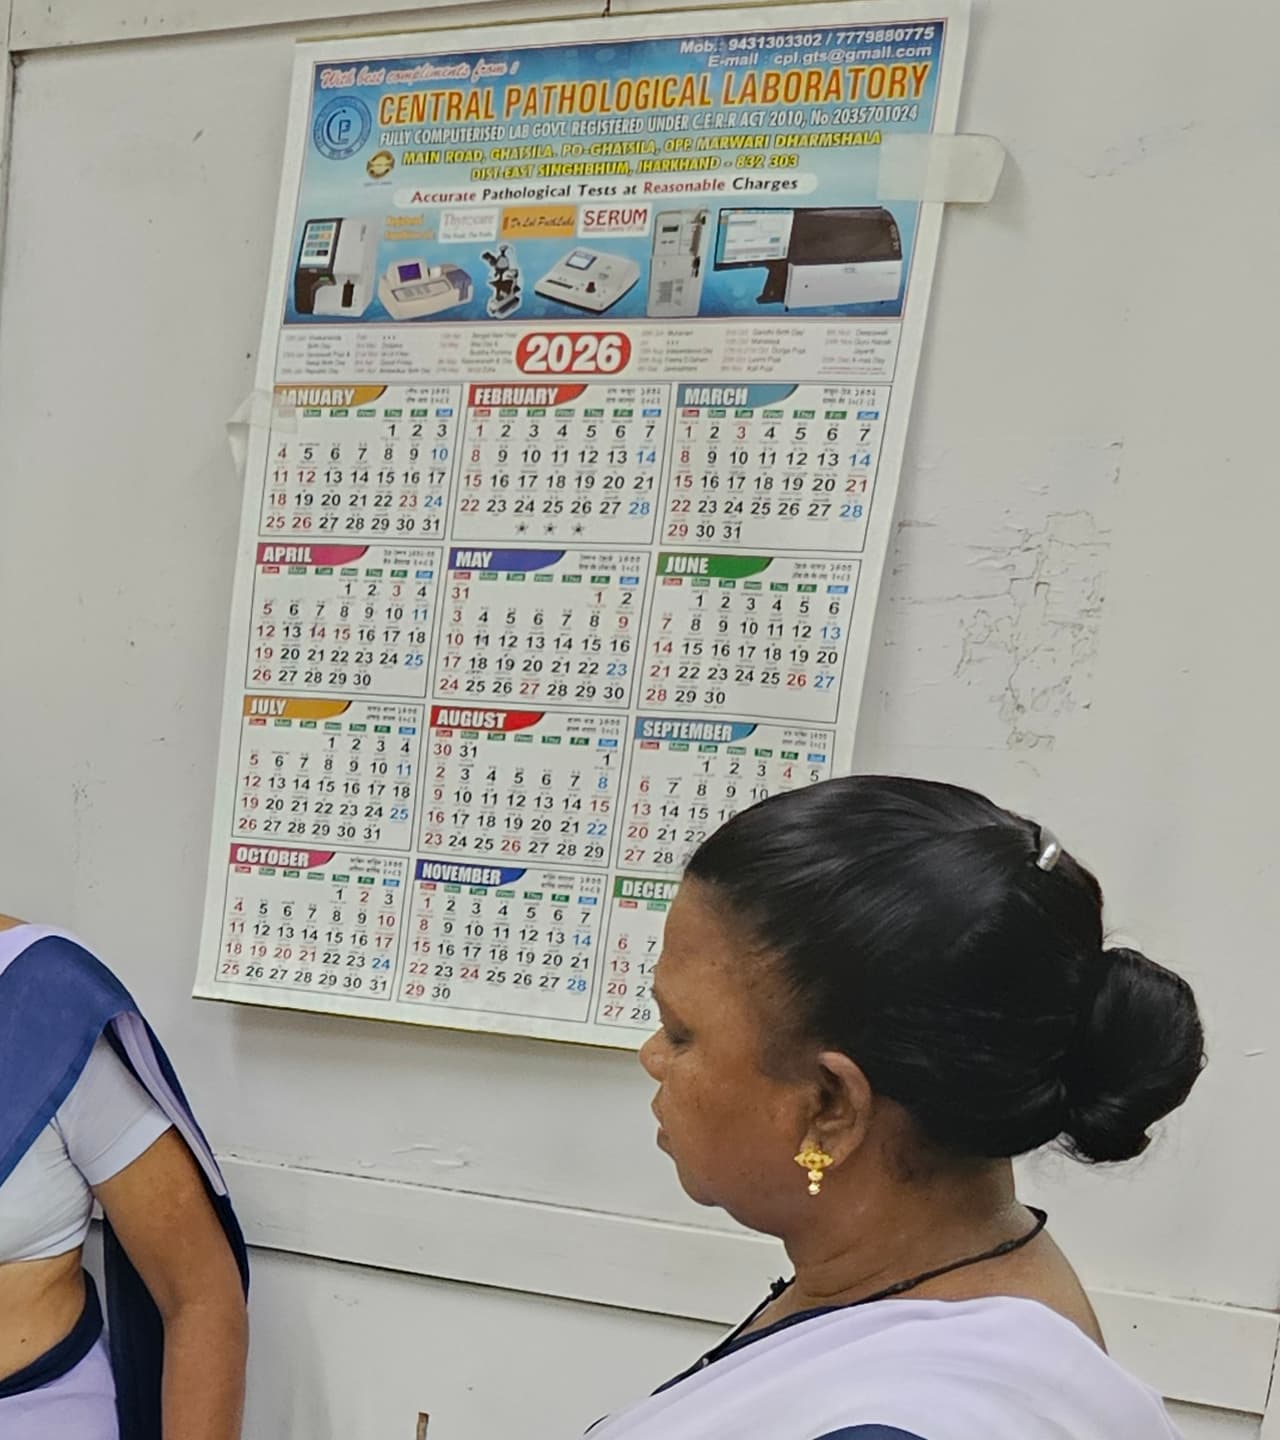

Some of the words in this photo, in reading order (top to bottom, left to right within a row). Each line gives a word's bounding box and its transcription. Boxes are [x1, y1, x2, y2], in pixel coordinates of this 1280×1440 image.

[728, 33, 822, 51] 9431303302
[825, 32, 833, 46] /
[836, 26, 935, 45] 7779880775
[708, 53, 759, 68] E-mail
[356, 66, 386, 86] best
[386, 62, 471, 86] compliments
[471, 58, 508, 83] from
[378, 89, 495, 127] CENTRAL
[504, 72, 712, 119] PATHOLOGICAL
[722, 62, 932, 106] LABORATORY
[379, 131, 411, 147] FULLY
[414, 127, 505, 144] COMPUTERISED
[509, 125, 529, 140] LAB
[571, 118, 644, 136] REGISTERED
[647, 115, 689, 132] UNDER
[741, 111, 766, 127] ACT
[831, 105, 918, 126] 2035701024
[402, 150, 439, 166] MAIN
[695, 134, 770, 151] MARWARI
[774, 131, 882, 149] DHARMSHALA
[636, 156, 721, 174] JHARKHAND
[735, 154, 765, 170] 832
[768, 154, 800, 169] 303
[410, 189, 477, 204] Accurate
[482, 184, 571, 201] Pathological
[578, 183, 617, 197] Tests
[623, 184, 637, 196] at
[643, 177, 726, 195] Reasonable
[731, 176, 799, 193] Charges
[583, 208, 648, 227] SERUM
[523, 335, 624, 373] 2026
[474, 387, 559, 405] FEBRUARY
[684, 387, 748, 406] MARCH
[278, 447, 286, 459] 4
[304, 447, 313, 460] 5
[330, 447, 340, 460] 6
[358, 448, 367, 460] 7
[384, 448, 393, 460] 8
[410, 448, 418, 461] 9
[432, 448, 448, 461] 10
[471, 449, 480, 463] 8
[498, 449, 508, 463] 9
[522, 450, 541, 463] 10
[552, 450, 568, 463] 11
[578, 450, 599, 464] 12
[608, 450, 627, 464] 13
[637, 450, 656, 464] 14
[274, 470, 288, 482] 11
[298, 470, 316, 483] 12
[324, 470, 342, 484] 13
[351, 470, 368, 483] 14
[378, 471, 395, 484] 15
[403, 472, 420, 484] 16
[429, 471, 446, 484] 17
[675, 474, 693, 488] 15
[701, 475, 719, 489] 16
[728, 476, 746, 489] 17
[754, 476, 774, 490] 18
[782, 477, 804, 491] 19
[813, 478, 835, 492] 20
[846, 479, 867, 493] 21
[262, 546, 312, 563] APRIL
[455, 551, 493, 568] MAY
[665, 557, 709, 574] JUNE
[257, 624, 275, 637] 12
[283, 625, 301, 638] 13
[310, 625, 326, 638] 14
[334, 628, 350, 640] 15
[358, 629, 375, 642] 16
[384, 630, 401, 642] 17
[408, 631, 426, 644] 18
[446, 633, 464, 646] 10
[475, 634, 489, 646] 11
[499, 635, 518, 648] 12
[526, 636, 545, 649] 13
[554, 637, 572, 650] 14
[582, 638, 601, 652] 15
[611, 639, 630, 653] 16
[654, 641, 672, 654] 14
[683, 642, 703, 656] 15
[712, 644, 730, 657] 16
[738, 645, 756, 658] 17
[764, 647, 782, 661] 18
[790, 649, 809, 663] 19
[816, 651, 838, 664] 20
[249, 699, 288, 715] JULY
[436, 708, 507, 729] AUGUST
[642, 721, 733, 741] SEPTEMBER
[244, 775, 262, 787] 12
[268, 776, 286, 789] 13
[293, 778, 310, 790] 14
[318, 780, 335, 792] 15
[343, 782, 360, 794] 16
[368, 783, 386, 796] 17
[393, 786, 410, 799] 18
[640, 780, 649, 792] 6
[669, 782, 679, 794] 7
[696, 784, 707, 796] 8
[726, 786, 736, 798] 9
[434, 788, 443, 800] 9
[454, 790, 472, 803] 10
[482, 792, 498, 805] 11
[508, 794, 526, 807] 12
[534, 796, 554, 809] 13
[563, 798, 581, 810] 14
[591, 800, 610, 813] 15
[632, 802, 651, 816] 13
[661, 805, 679, 818] 14
[689, 807, 709, 820] 15
[235, 847, 310, 867] OCTOBER
[421, 861, 502, 885] NOVEMBER
[230, 921, 244, 933] 11
[254, 924, 270, 936] 12
[278, 926, 294, 938] 13
[302, 928, 318, 940] 14
[326, 931, 343, 944] 15
[351, 933, 368, 946] 16
[376, 936, 393, 948] 17
[414, 940, 430, 953] 15
[438, 943, 455, 956] 16
[463, 946, 482, 958] 17
[489, 948, 508, 962] 18
[517, 951, 535, 964] 19
[542, 953, 563, 967] 20
[570, 956, 589, 969] 21
[618, 938, 628, 950] 6
[647, 940, 656, 952] 7
[603, 1004, 624, 1018] 27
[630, 1008, 651, 1021] 28
